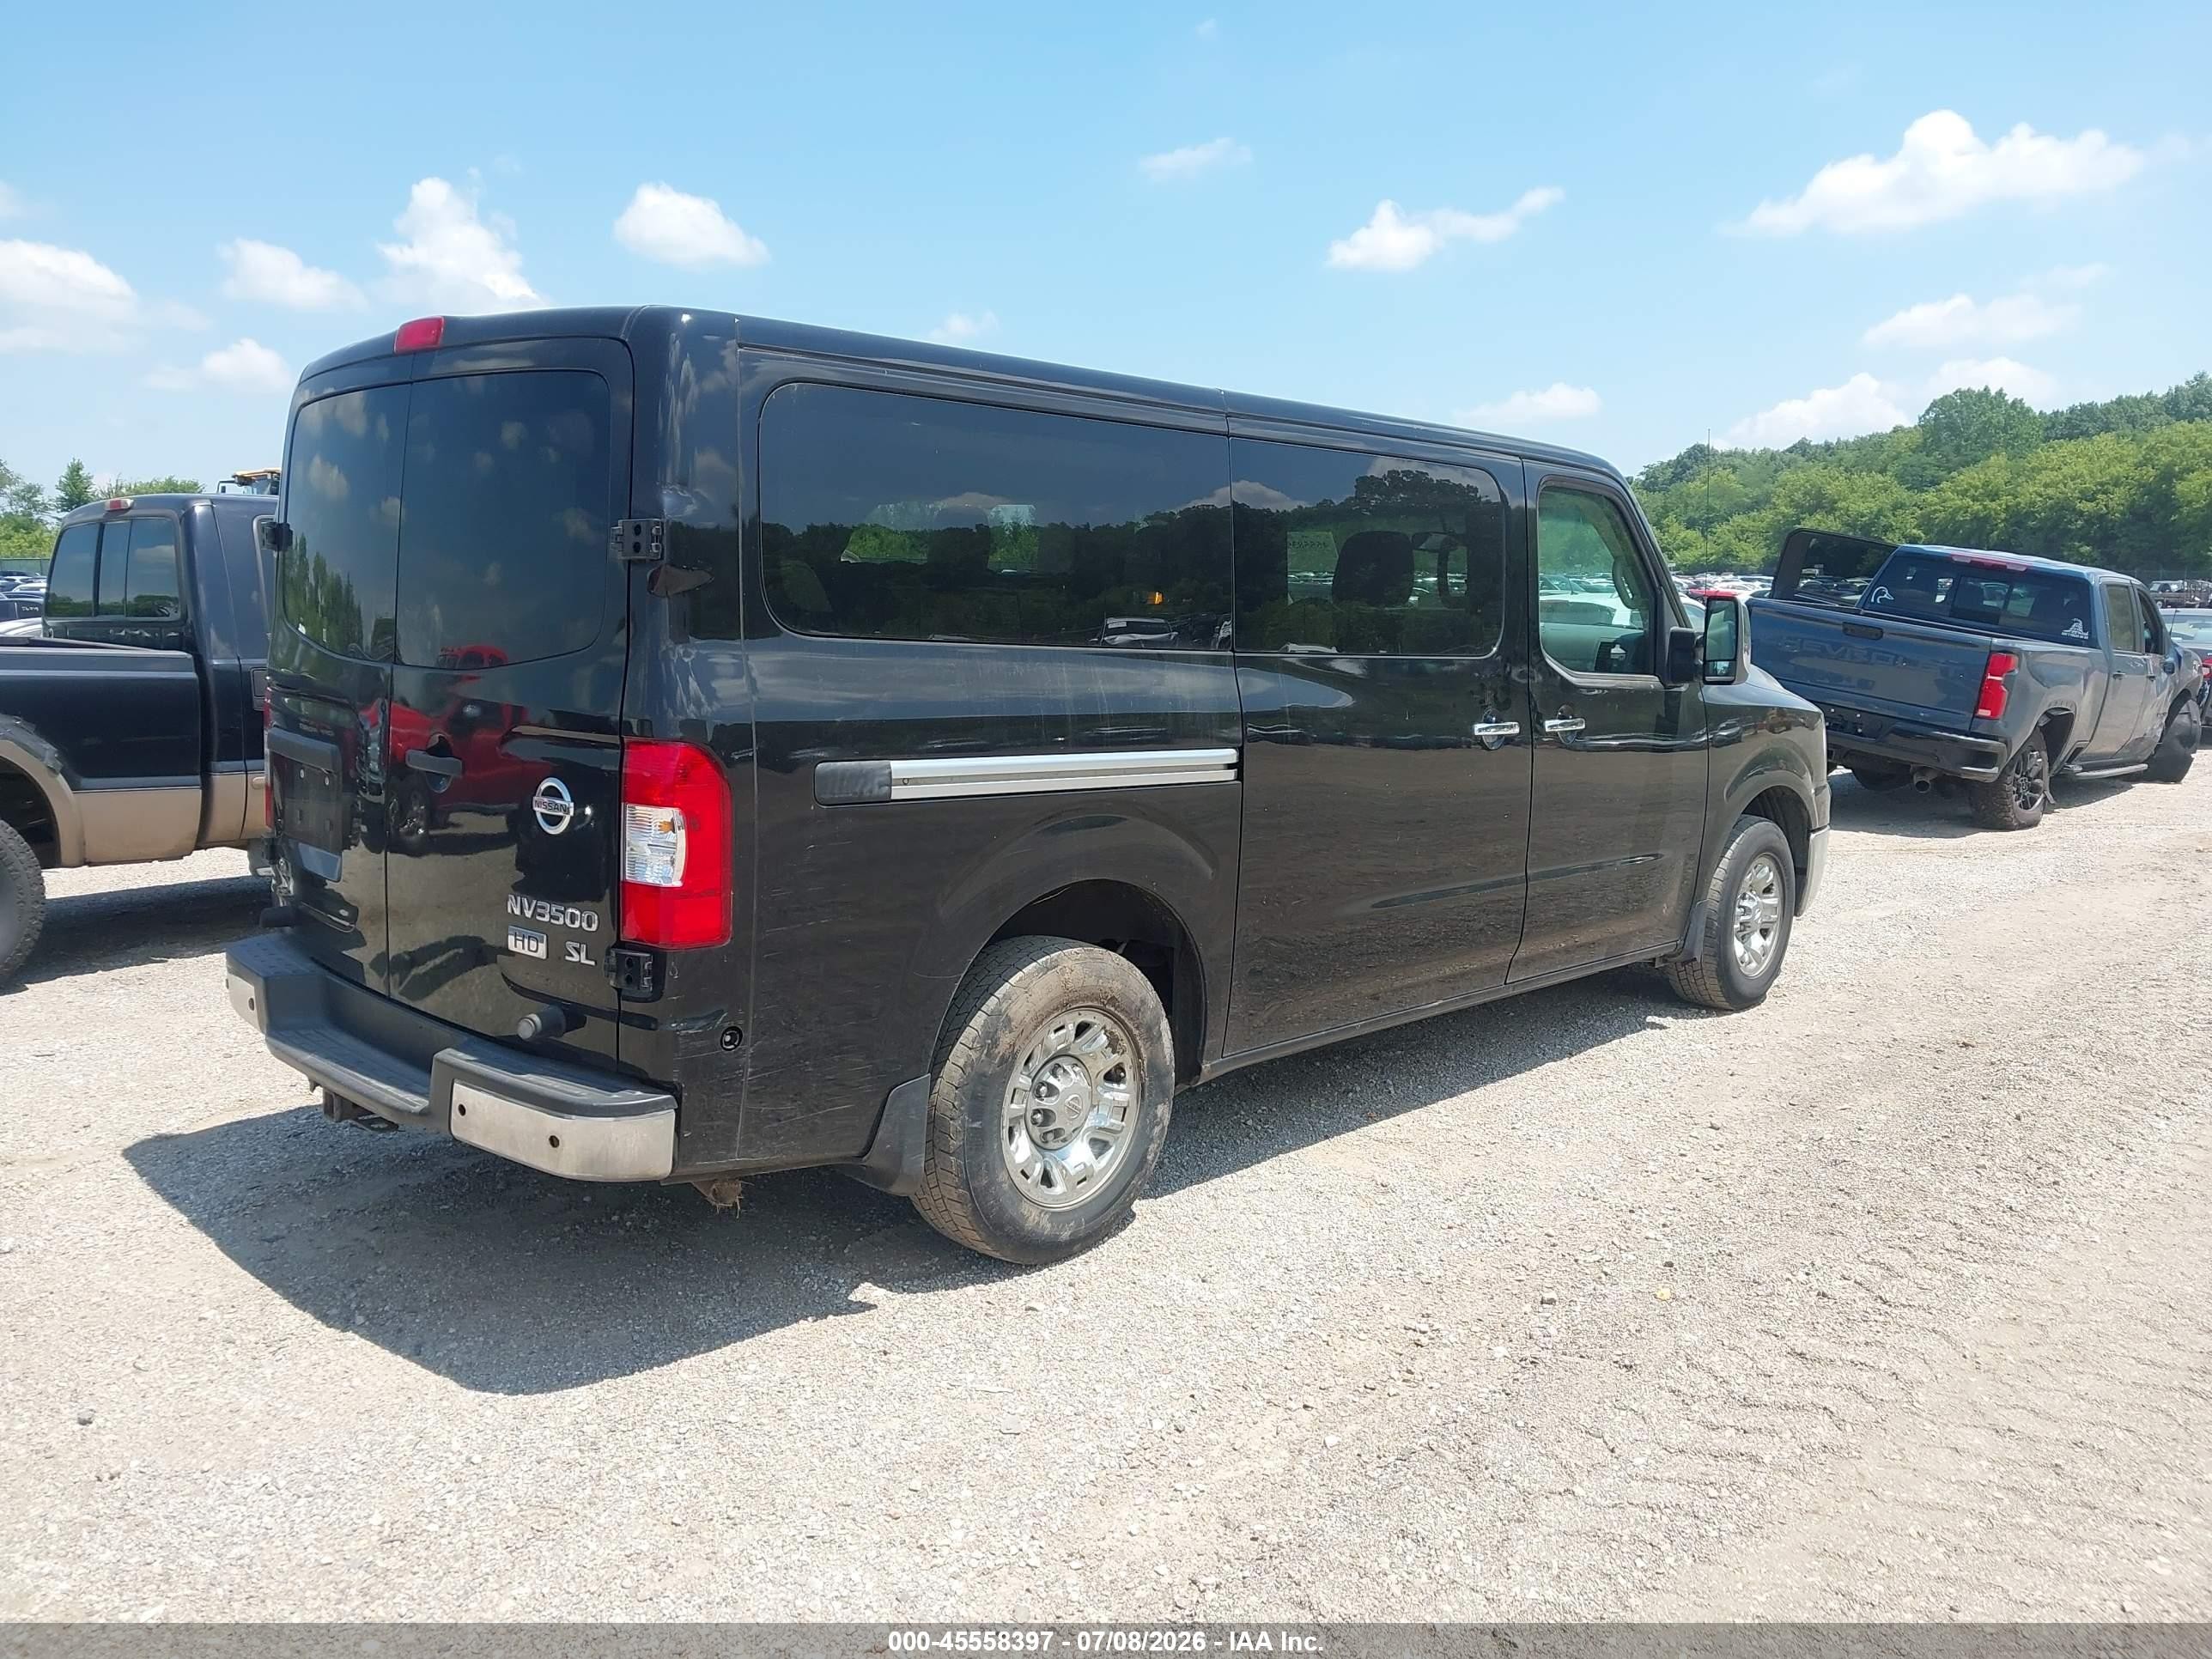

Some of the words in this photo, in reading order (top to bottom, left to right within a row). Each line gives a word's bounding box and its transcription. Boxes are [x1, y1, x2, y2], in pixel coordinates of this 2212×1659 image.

[534, 799, 568, 814] NISSAN
[507, 894, 599, 932] NV3500
[514, 931, 540, 955] HD
[565, 940, 596, 966] SL
